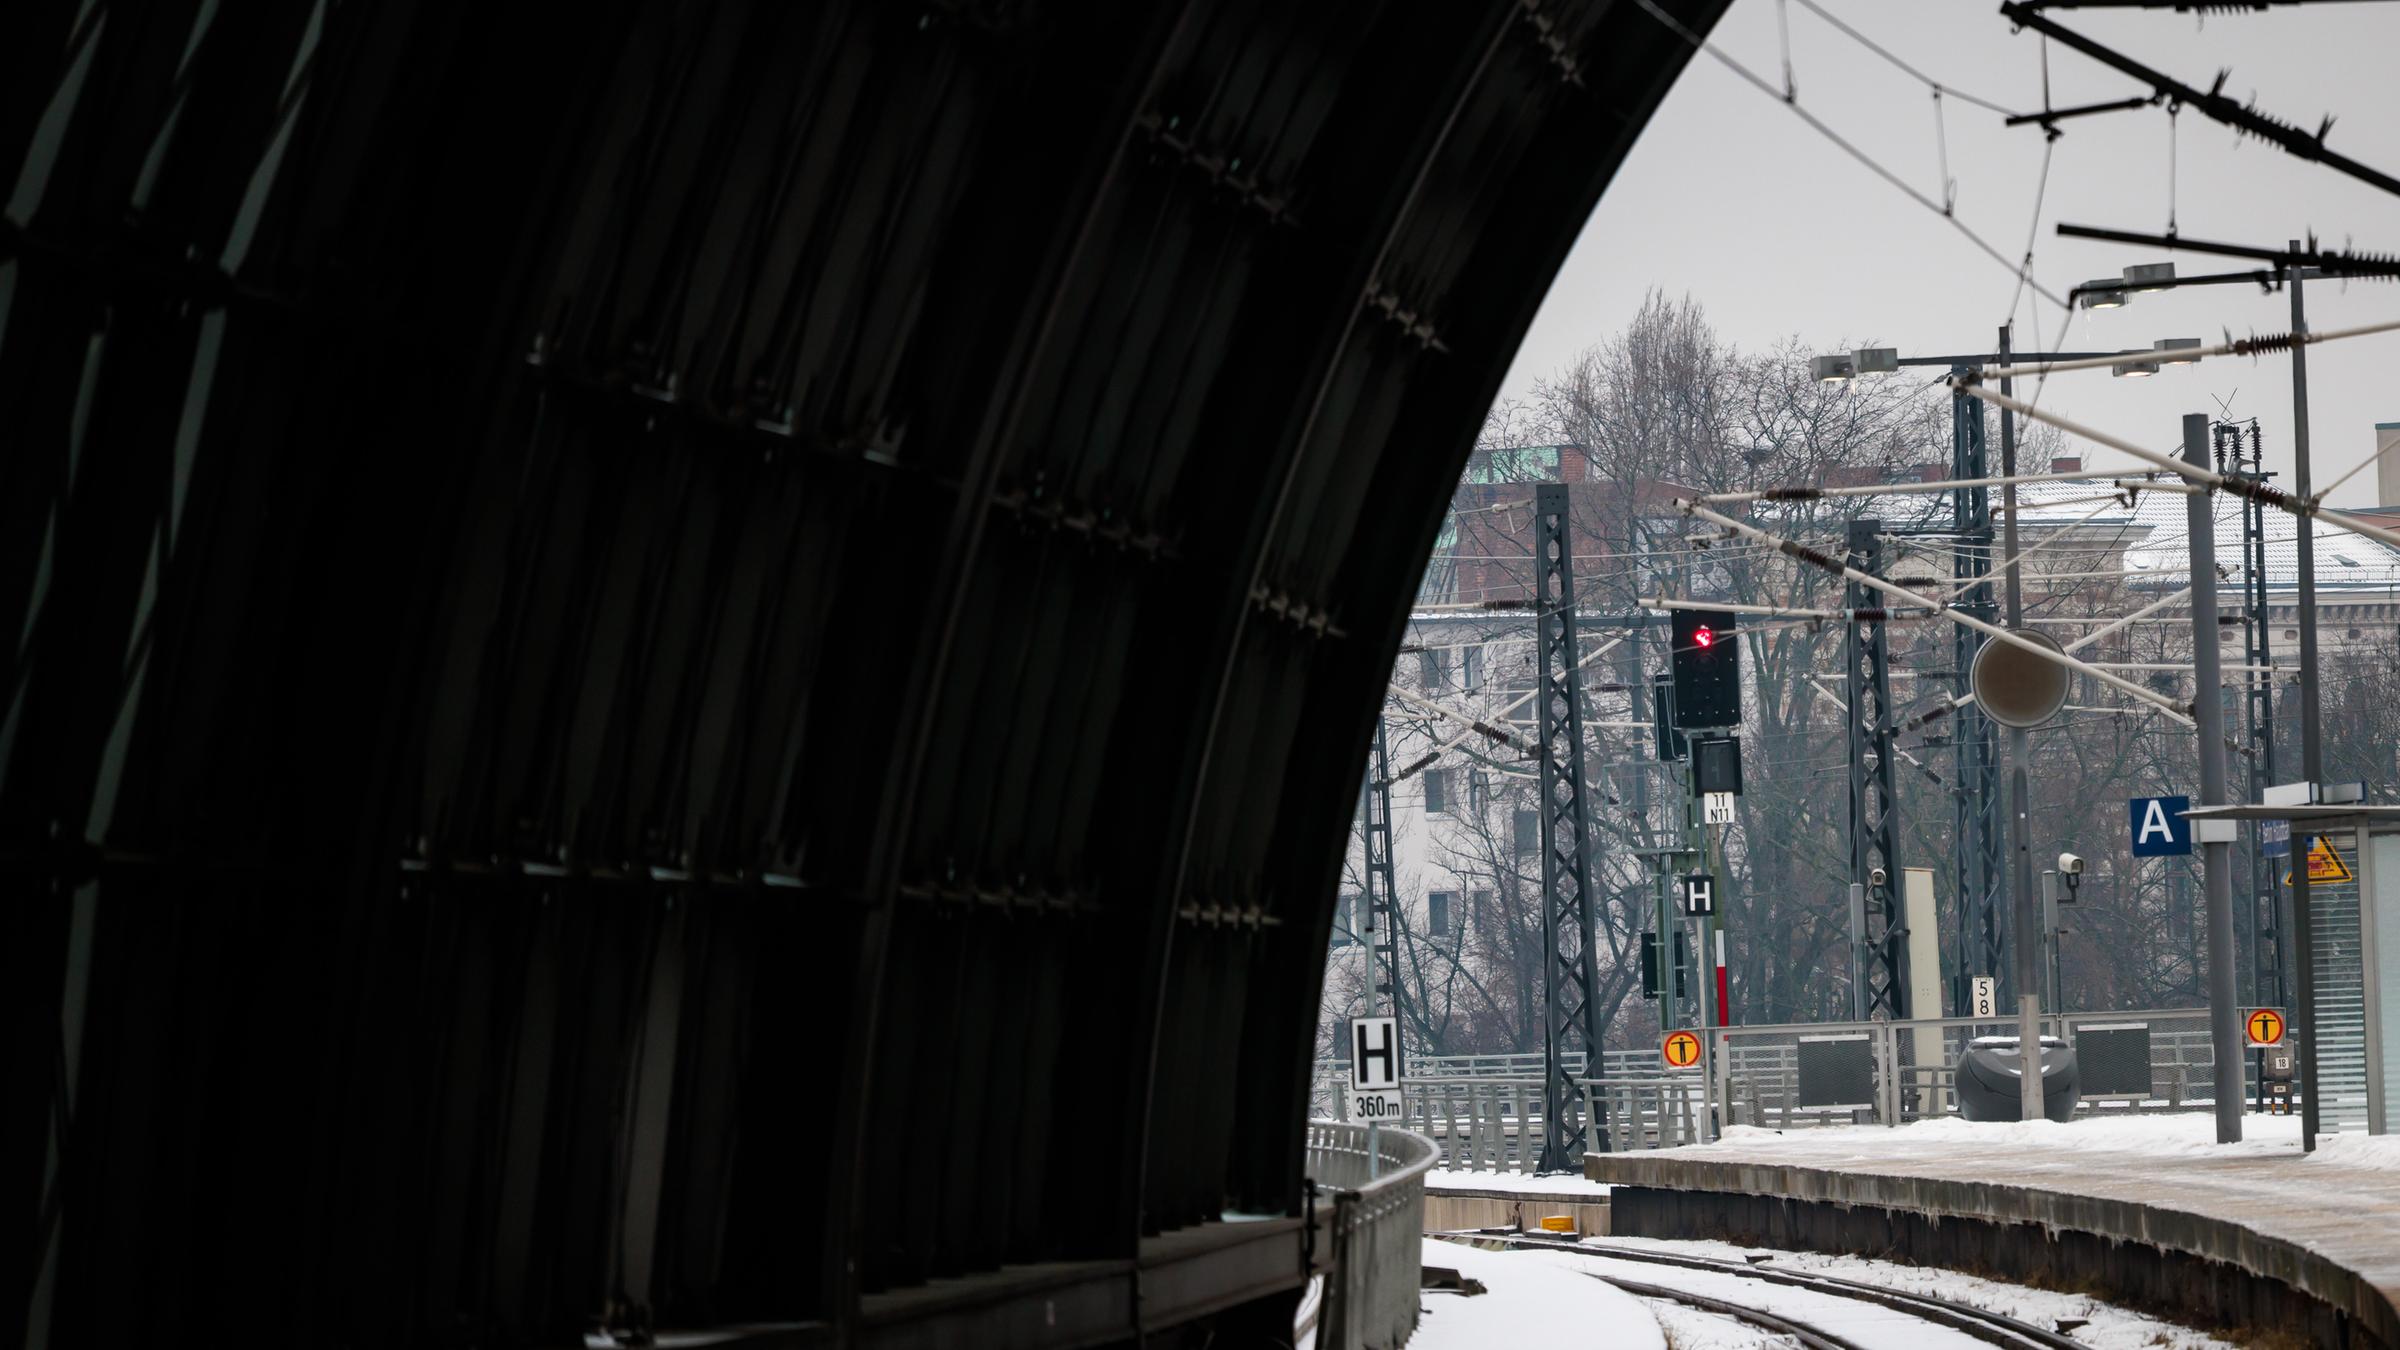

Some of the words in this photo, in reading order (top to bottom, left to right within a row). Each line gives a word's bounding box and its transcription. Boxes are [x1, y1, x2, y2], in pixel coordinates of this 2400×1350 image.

[1715, 794, 1725, 807] 11
[1711, 808, 1729, 821] N11
[2137, 800, 2174, 844] A
[1689, 881, 1711, 911] H
[1979, 981, 1989, 997] 5
[1980, 999, 1989, 1015] 8
[1357, 1023, 1395, 1083] H
[2278, 1058, 2287, 1068] 18
